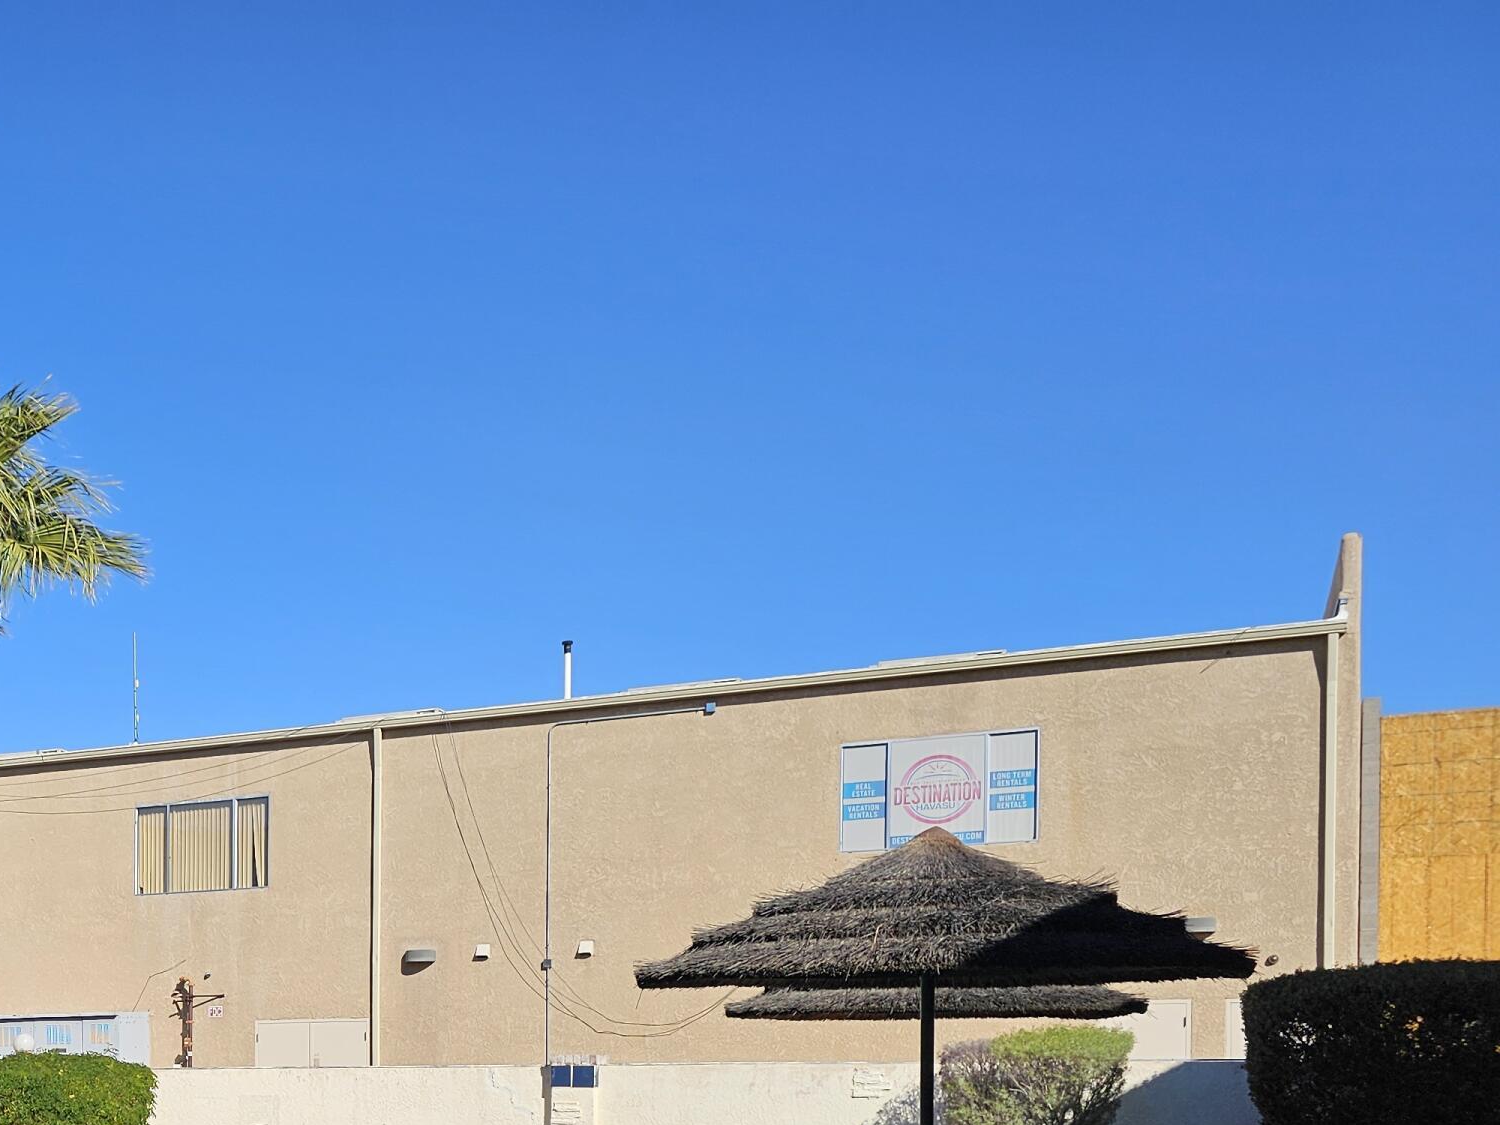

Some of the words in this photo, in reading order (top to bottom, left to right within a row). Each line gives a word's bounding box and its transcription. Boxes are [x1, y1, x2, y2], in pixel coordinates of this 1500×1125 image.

[992, 771, 1011, 781] LONG
[1012, 770, 1032, 779] TERM
[855, 782, 871, 790] REAL
[996, 778, 1028, 787] RENTALS
[851, 789, 876, 798] ESTATE
[893, 780, 981, 806] DESTINATION
[998, 794, 1025, 802] WINTER
[847, 804, 880, 813] VACATION
[915, 801, 956, 811] HAVASU
[996, 801, 1028, 810] RENTALS
[849, 811, 878, 820] RENTALS
